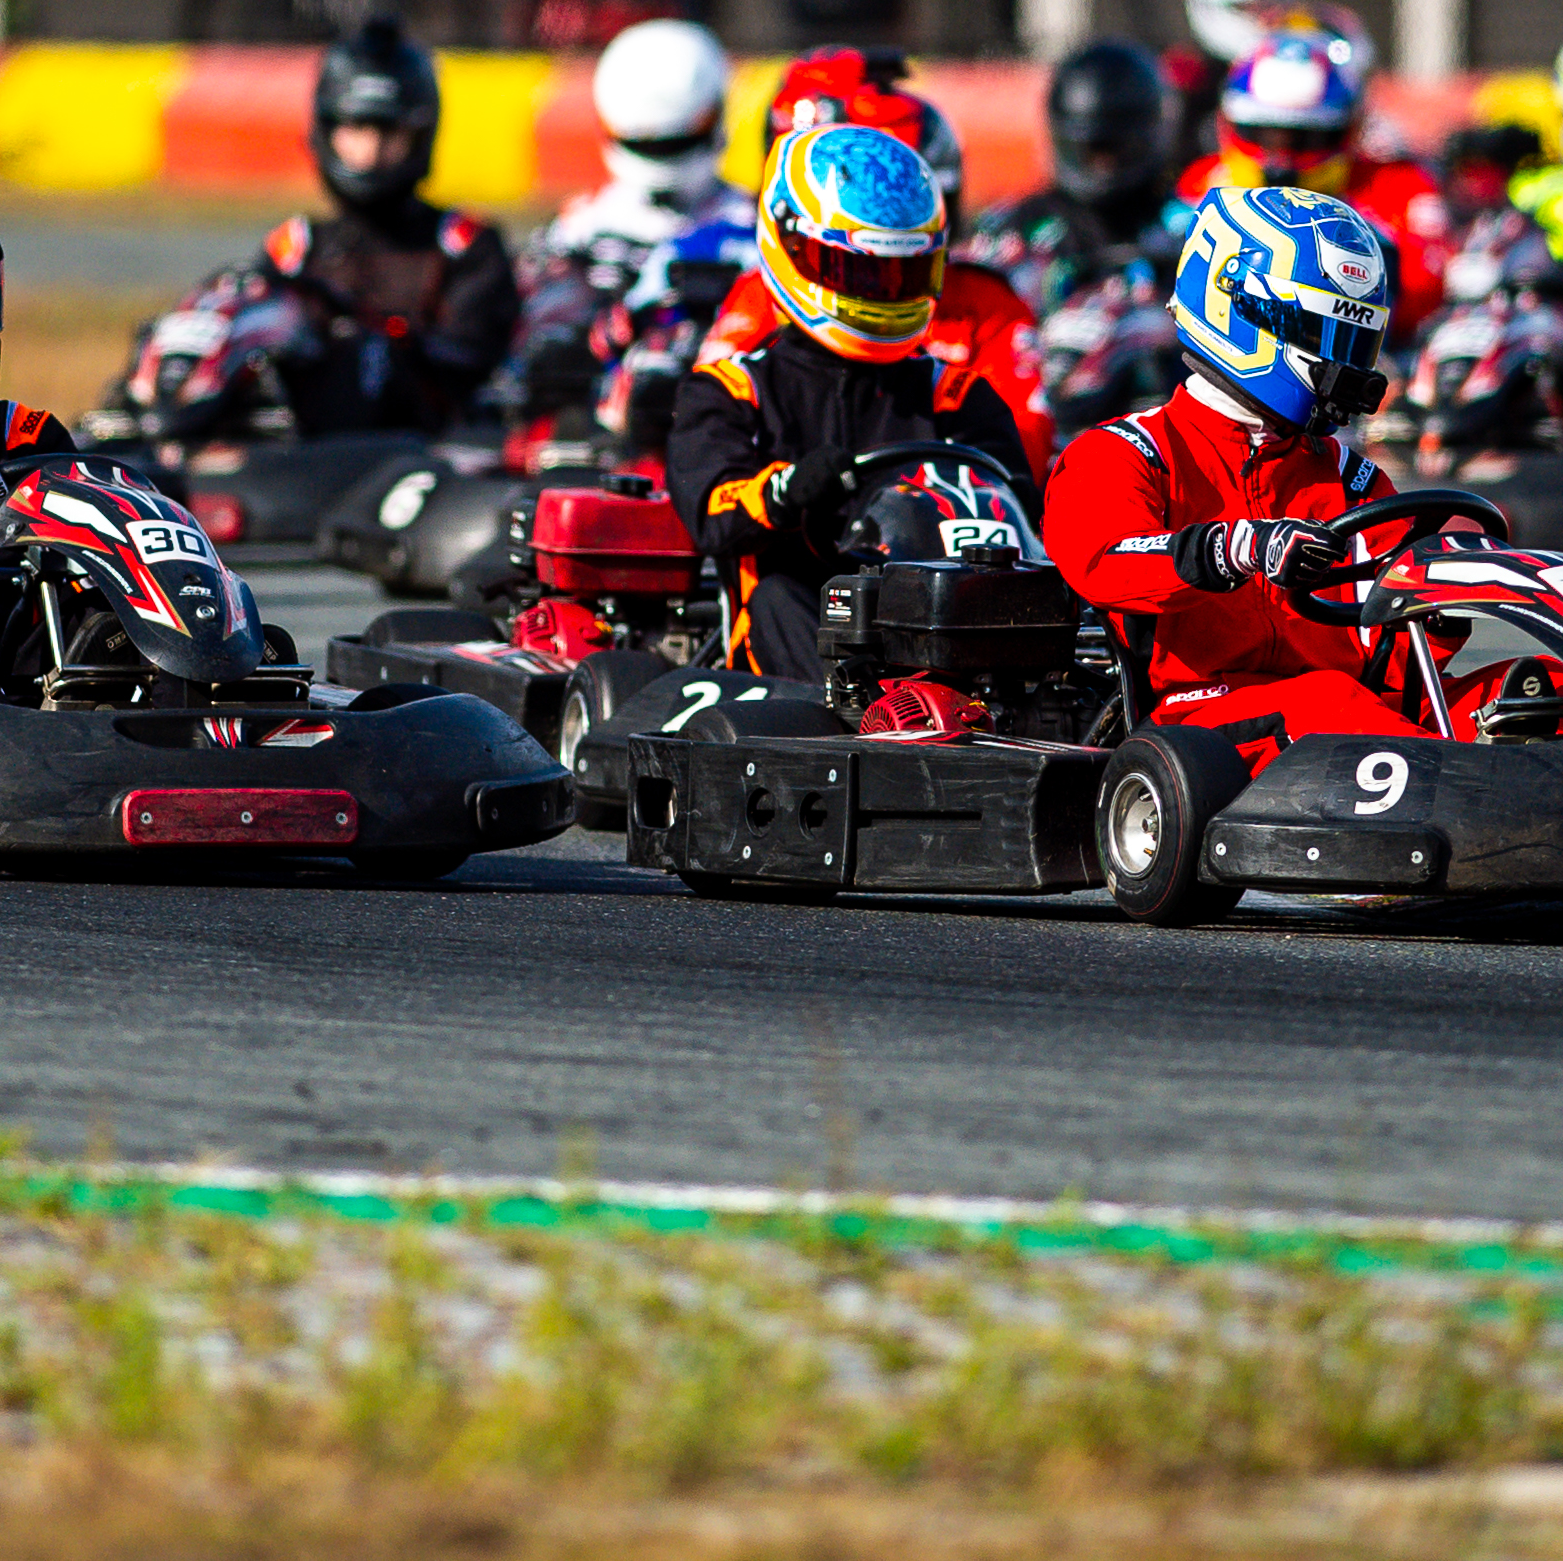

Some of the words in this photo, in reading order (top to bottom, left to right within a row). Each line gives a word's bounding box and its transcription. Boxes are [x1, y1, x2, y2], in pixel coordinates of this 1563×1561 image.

[1342, 264, 1368, 280] BELL
[380, 471, 437, 530] 6
[141, 527, 208, 558] 30
[1354, 751, 1410, 816] 9
